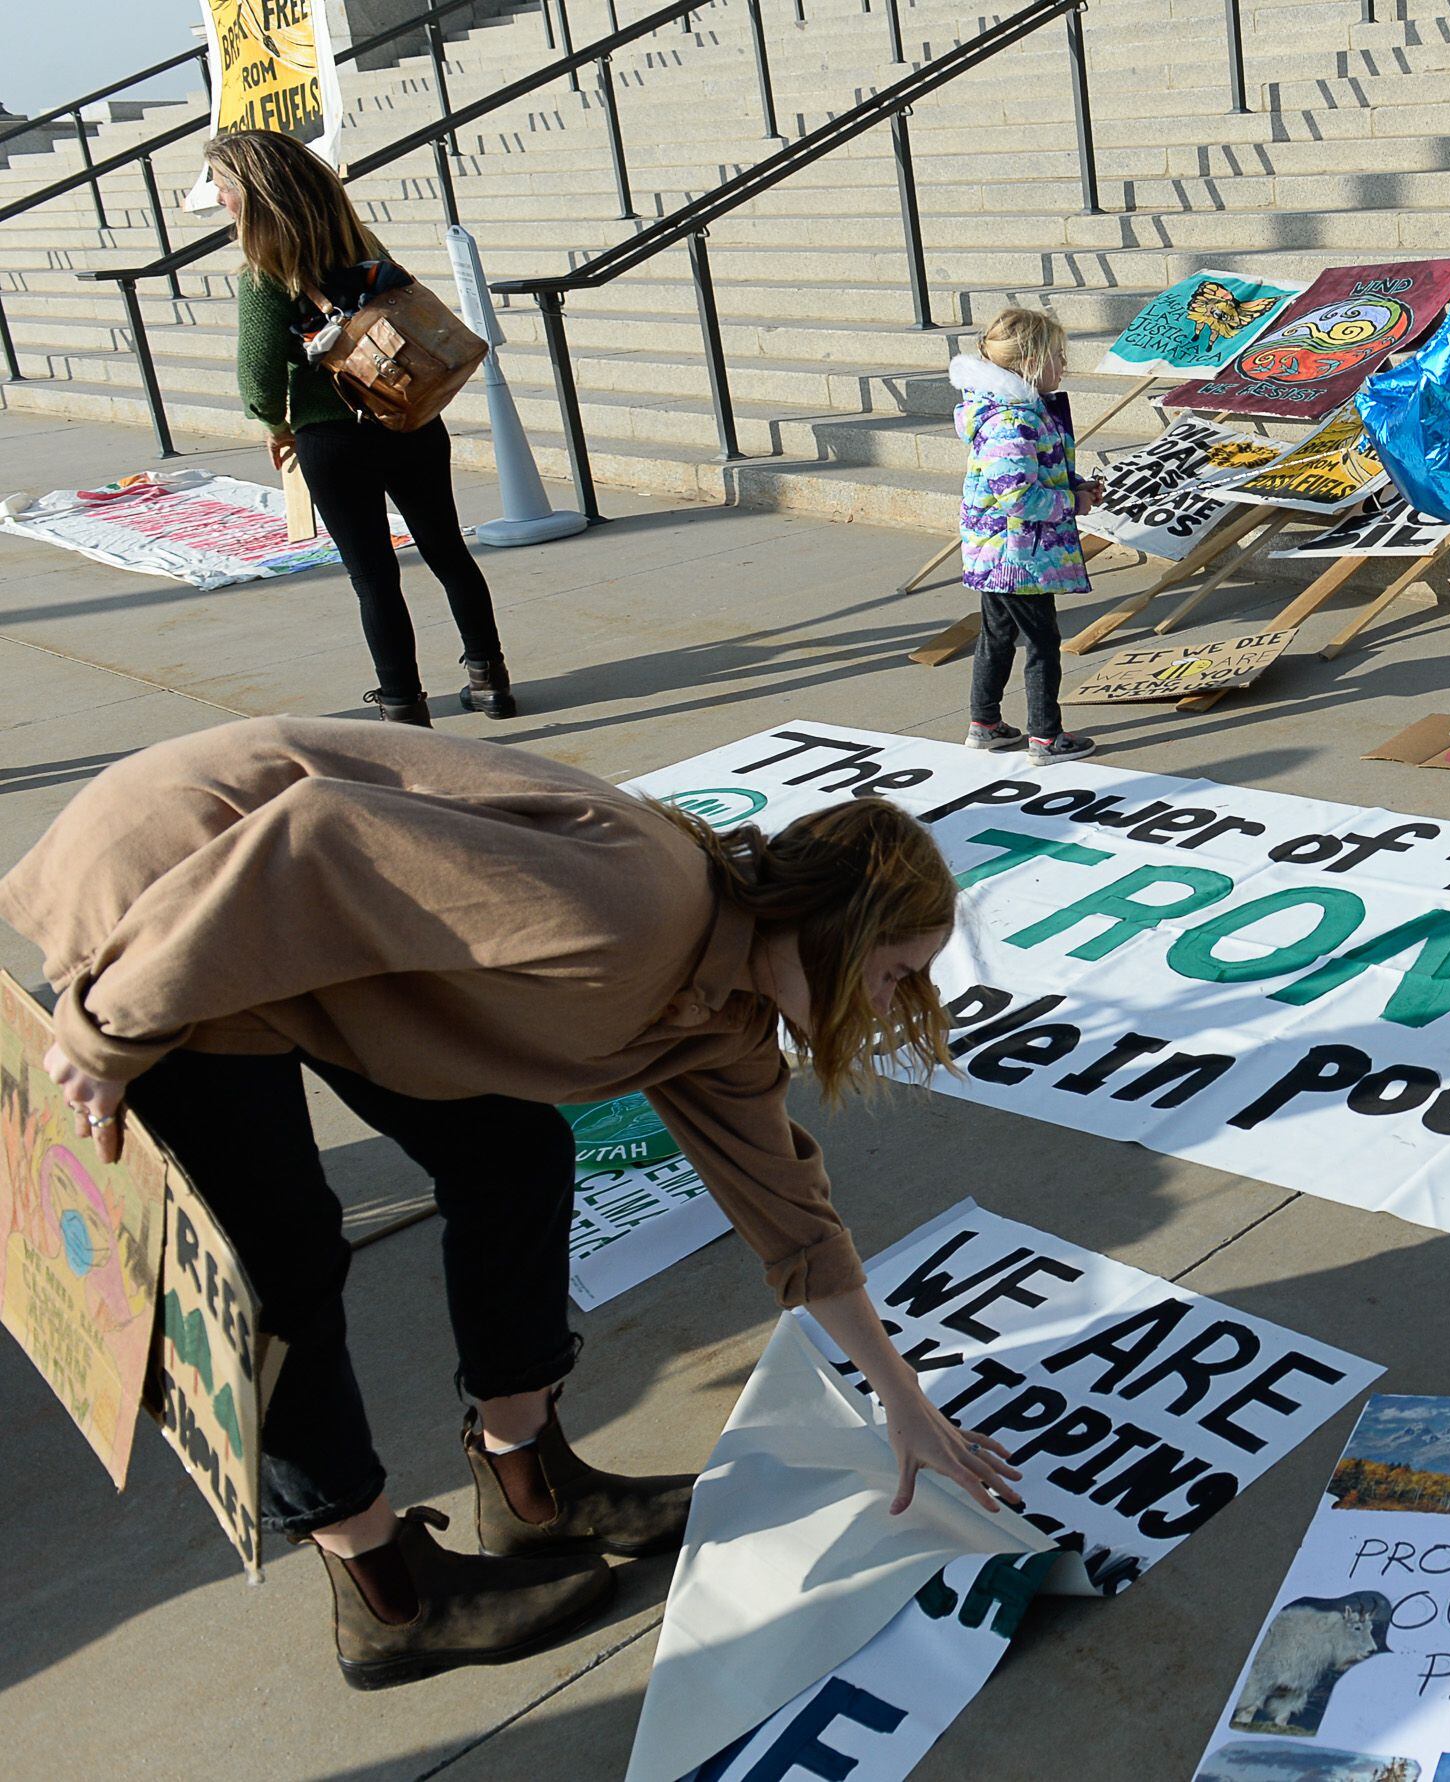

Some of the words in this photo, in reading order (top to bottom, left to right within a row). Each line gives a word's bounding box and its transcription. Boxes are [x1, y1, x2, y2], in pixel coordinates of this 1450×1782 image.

[262, 0, 309, 32] FREE
[242, 57, 278, 92] ROM
[1352, 277, 1414, 296] WIND
[1146, 305, 1170, 325] LA
[1161, 293, 1188, 322] HACIA
[1128, 317, 1200, 355] JUSTICIA
[1197, 382, 1240, 395] WE
[1235, 382, 1328, 402] RESIST
[1168, 423, 1221, 450] OIL
[1142, 438, 1212, 480] OAL
[1107, 469, 1226, 521] LIMATE
[1297, 473, 1357, 501] FUELS
[1101, 488, 1202, 537] HAOS
[1115, 650, 1174, 666] IF
[1183, 641, 1226, 659] WE
[1235, 631, 1288, 650] DIE
[1078, 679, 1186, 695] TAKING
[1199, 665, 1255, 681] YOU
[1096, 669, 1142, 682] WE
[1213, 649, 1283, 668] ARE
[732, 731, 934, 800] The
[916, 778, 1266, 850] power
[1266, 823, 1441, 873] of
[575, 1141, 648, 1162] UTAH
[172, 1190, 254, 1383] REES
[883, 1230, 1086, 1345] WE
[1040, 1297, 1347, 1455] ARE
